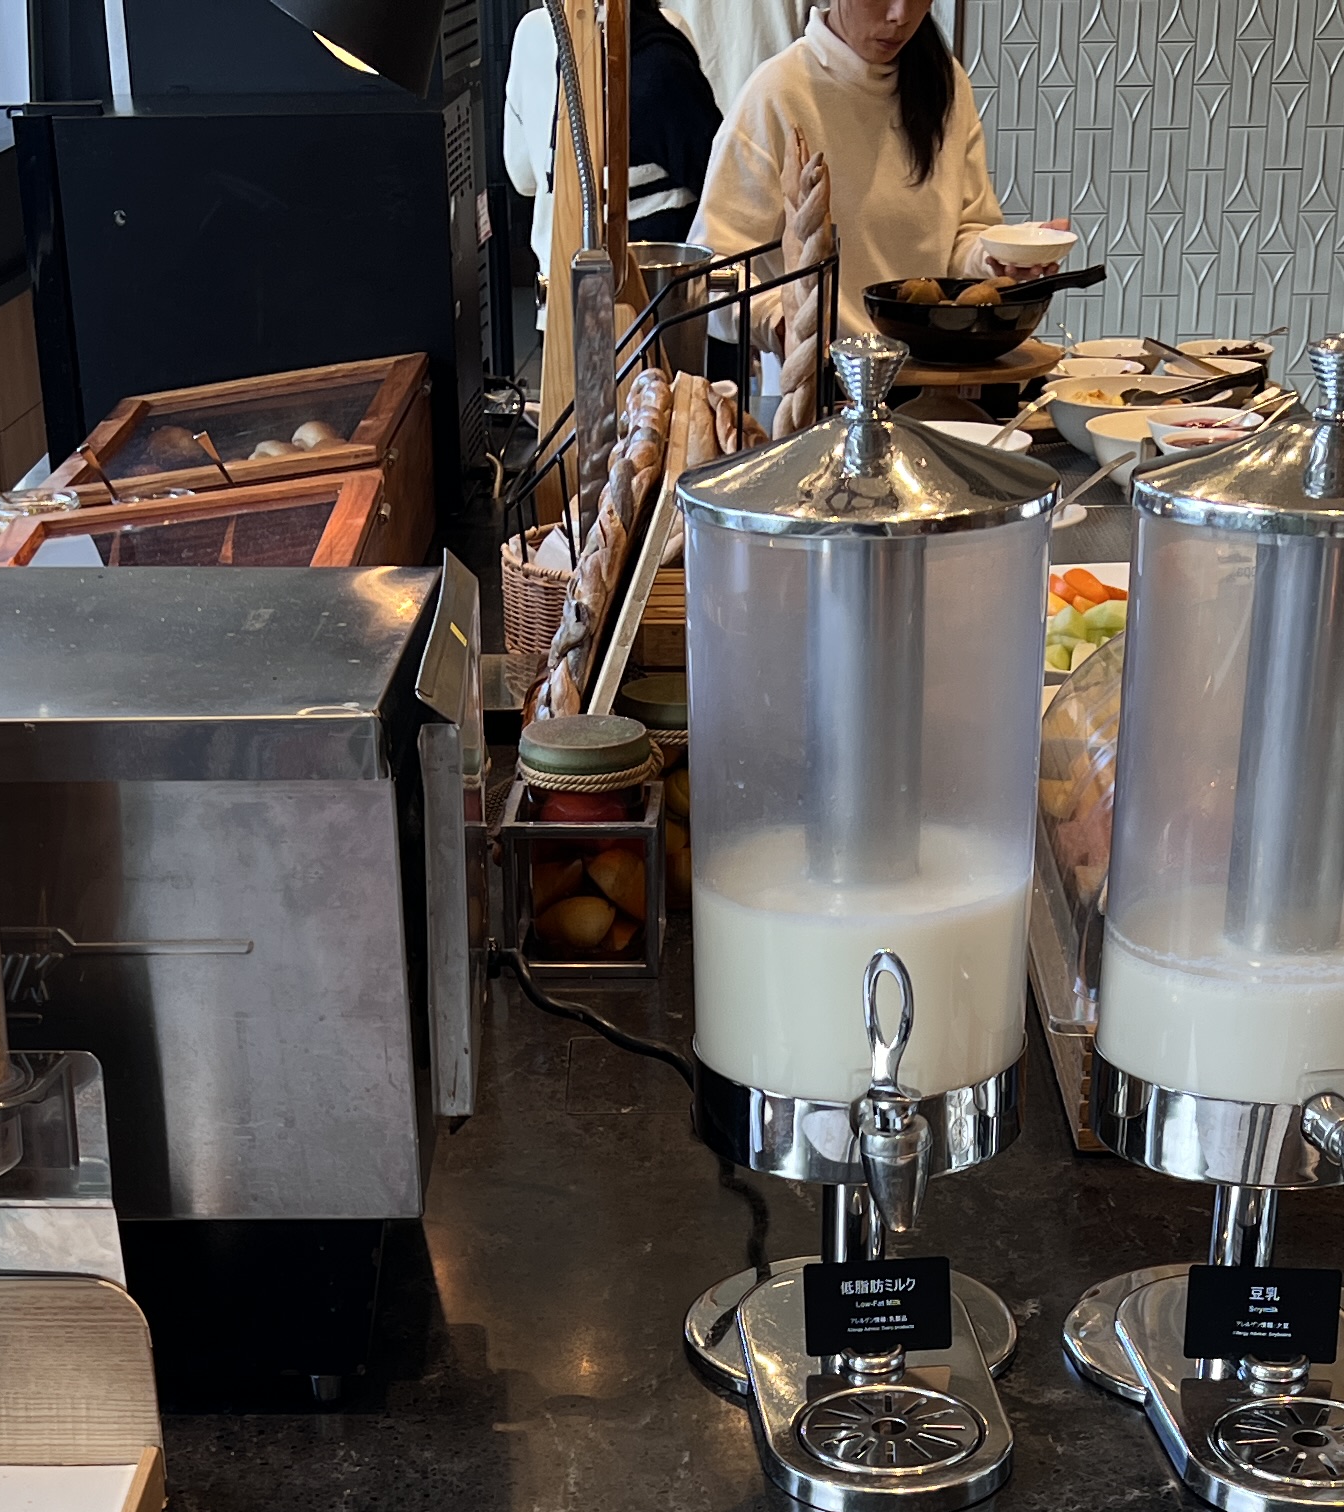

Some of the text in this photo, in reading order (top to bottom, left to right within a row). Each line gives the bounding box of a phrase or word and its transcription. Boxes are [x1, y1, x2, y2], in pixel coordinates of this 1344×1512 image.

[840, 1277, 916, 1296] 低脂肪ミルク
[1248, 1286, 1281, 1302] 豆乳
[855, 1299, 885, 1309] Low-Fat
